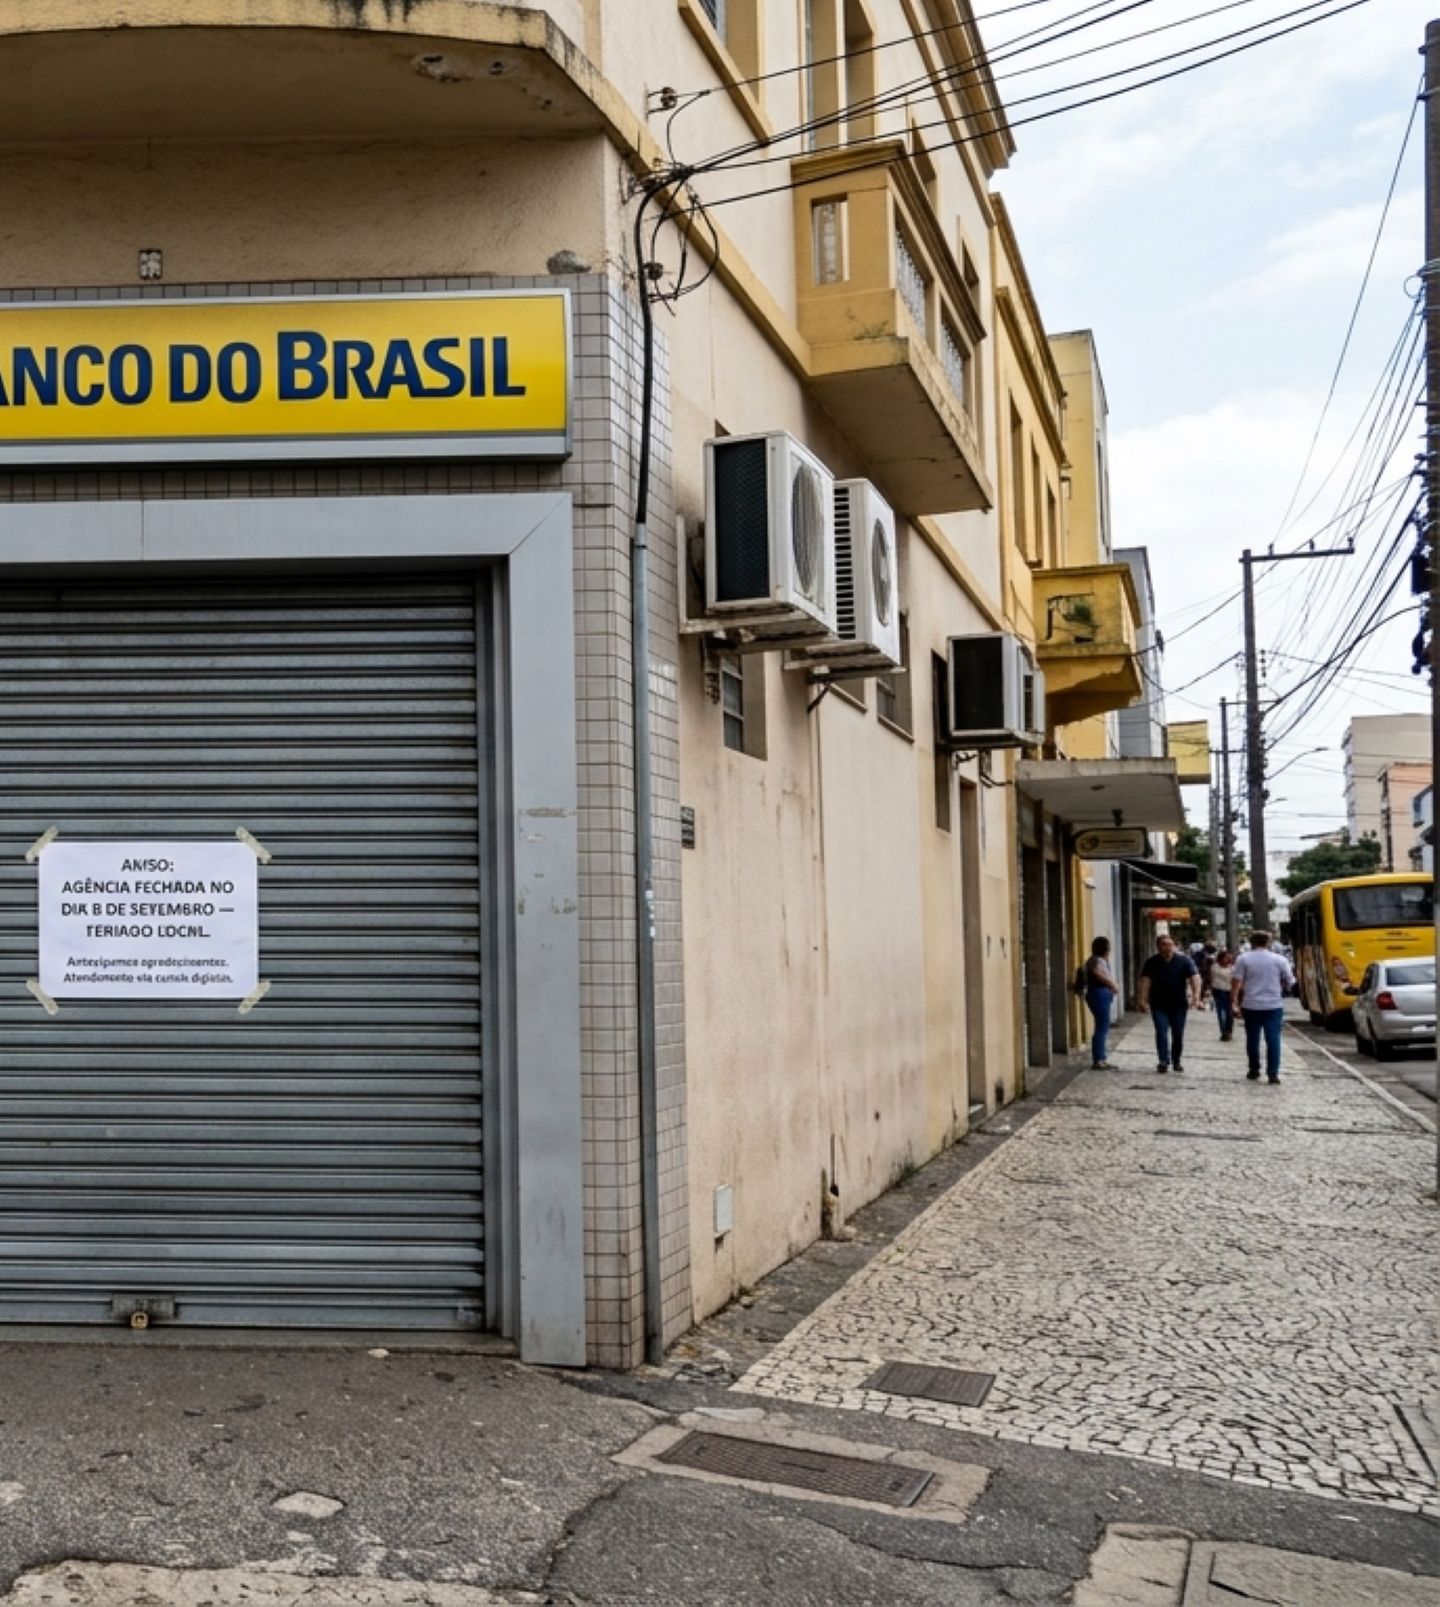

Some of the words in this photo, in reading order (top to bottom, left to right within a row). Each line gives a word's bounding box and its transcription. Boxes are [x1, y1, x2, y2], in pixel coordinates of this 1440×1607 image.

[168, 341, 261, 404] DO
[277, 330, 526, 401] BRASIL
[62, 877, 131, 893] AGÊNCIA
[135, 881, 206, 893] FECHADA
[210, 881, 235, 893] NO
[106, 903, 126, 916] DE
